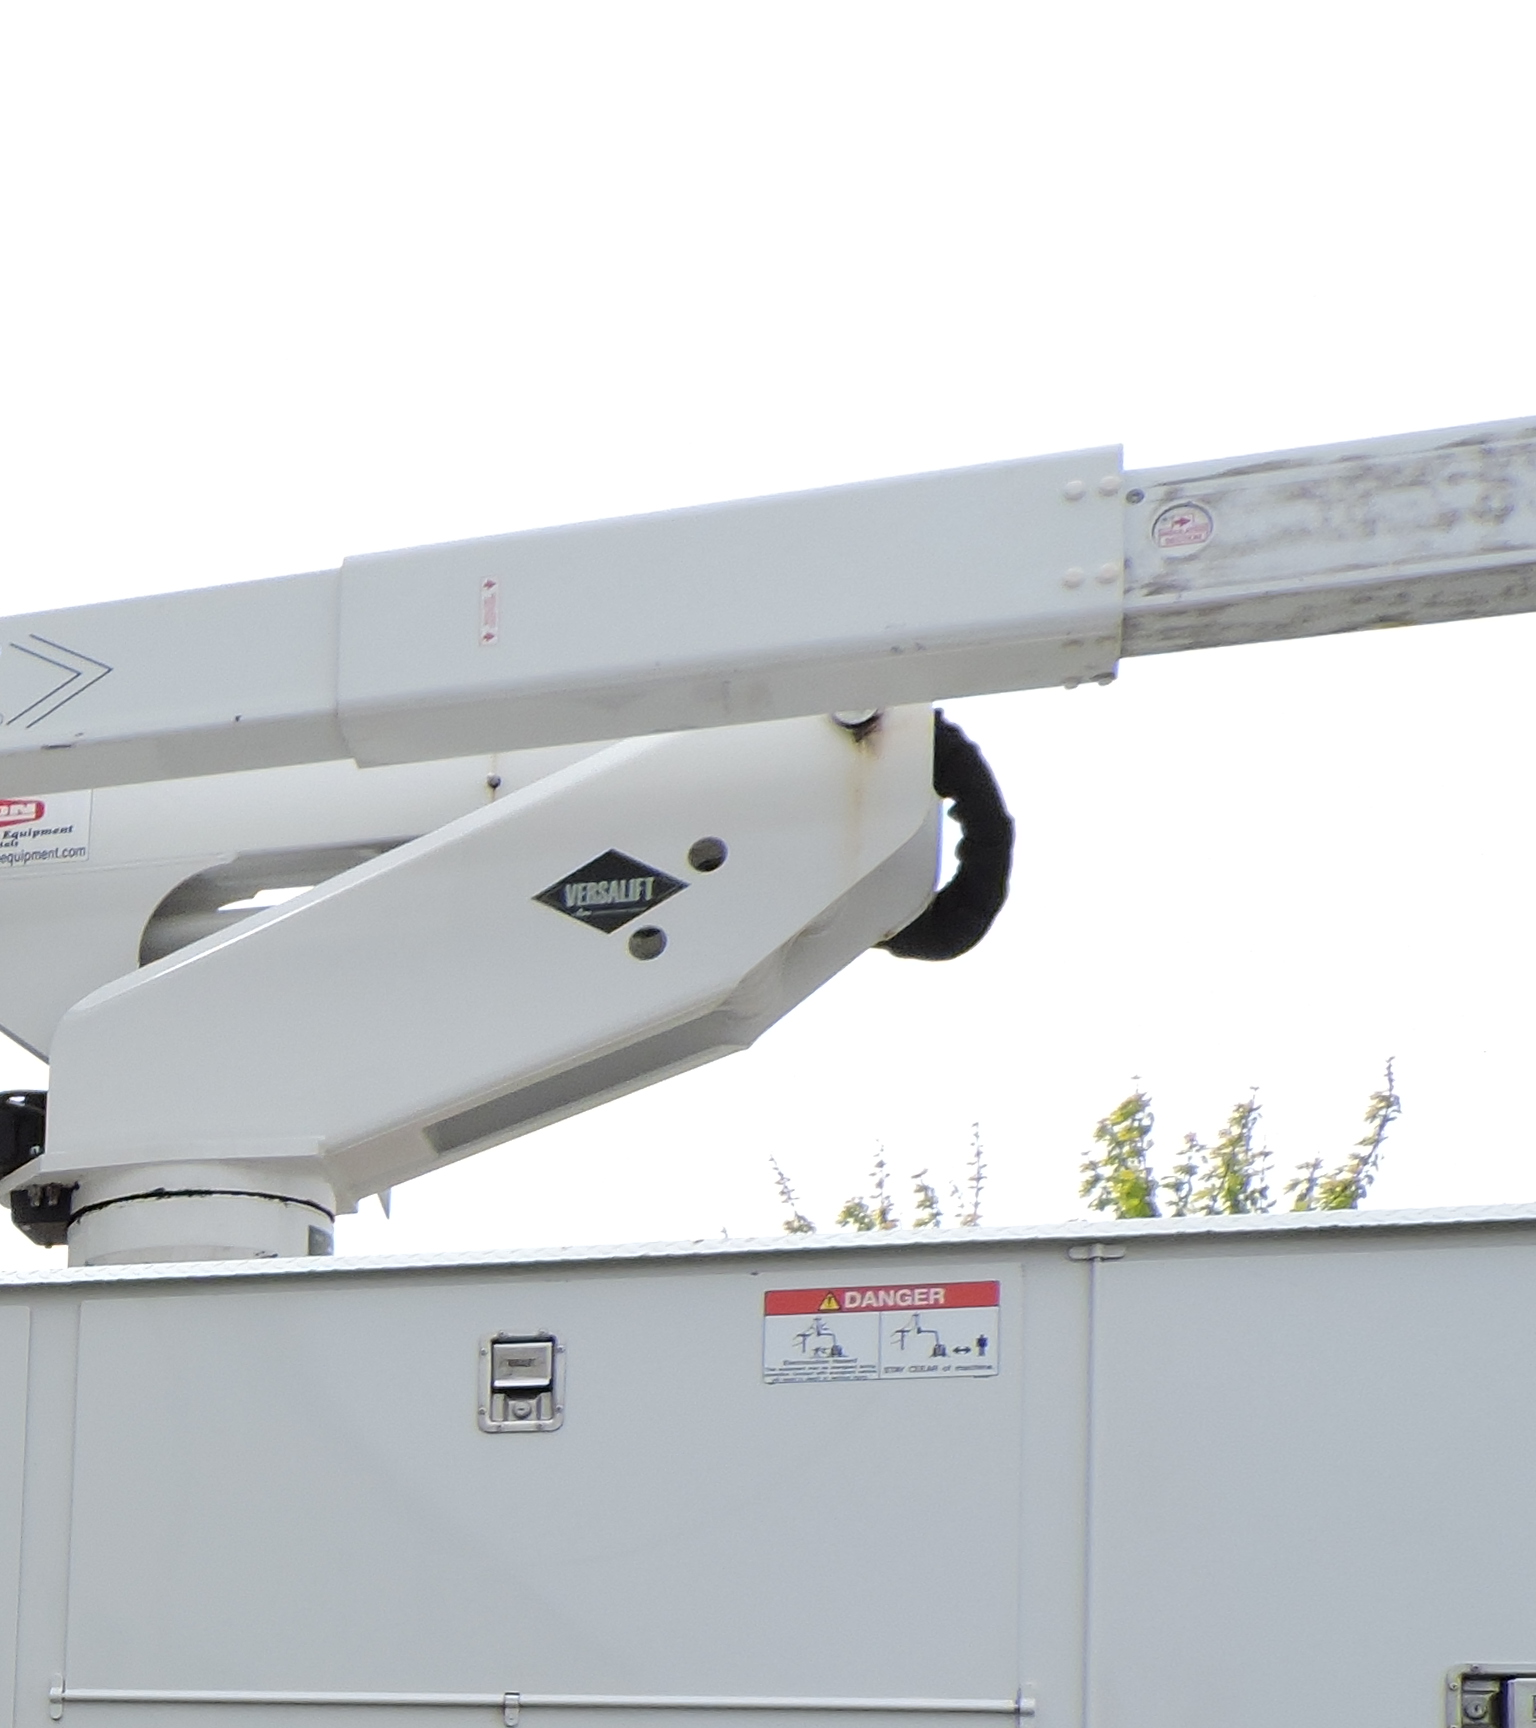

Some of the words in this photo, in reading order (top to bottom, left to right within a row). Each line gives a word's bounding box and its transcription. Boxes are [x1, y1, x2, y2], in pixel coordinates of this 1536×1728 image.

[2, 825, 74, 840] Equipment
[565, 877, 655, 907] VERSALIFT
[844, 1287, 946, 1309] DANGER
